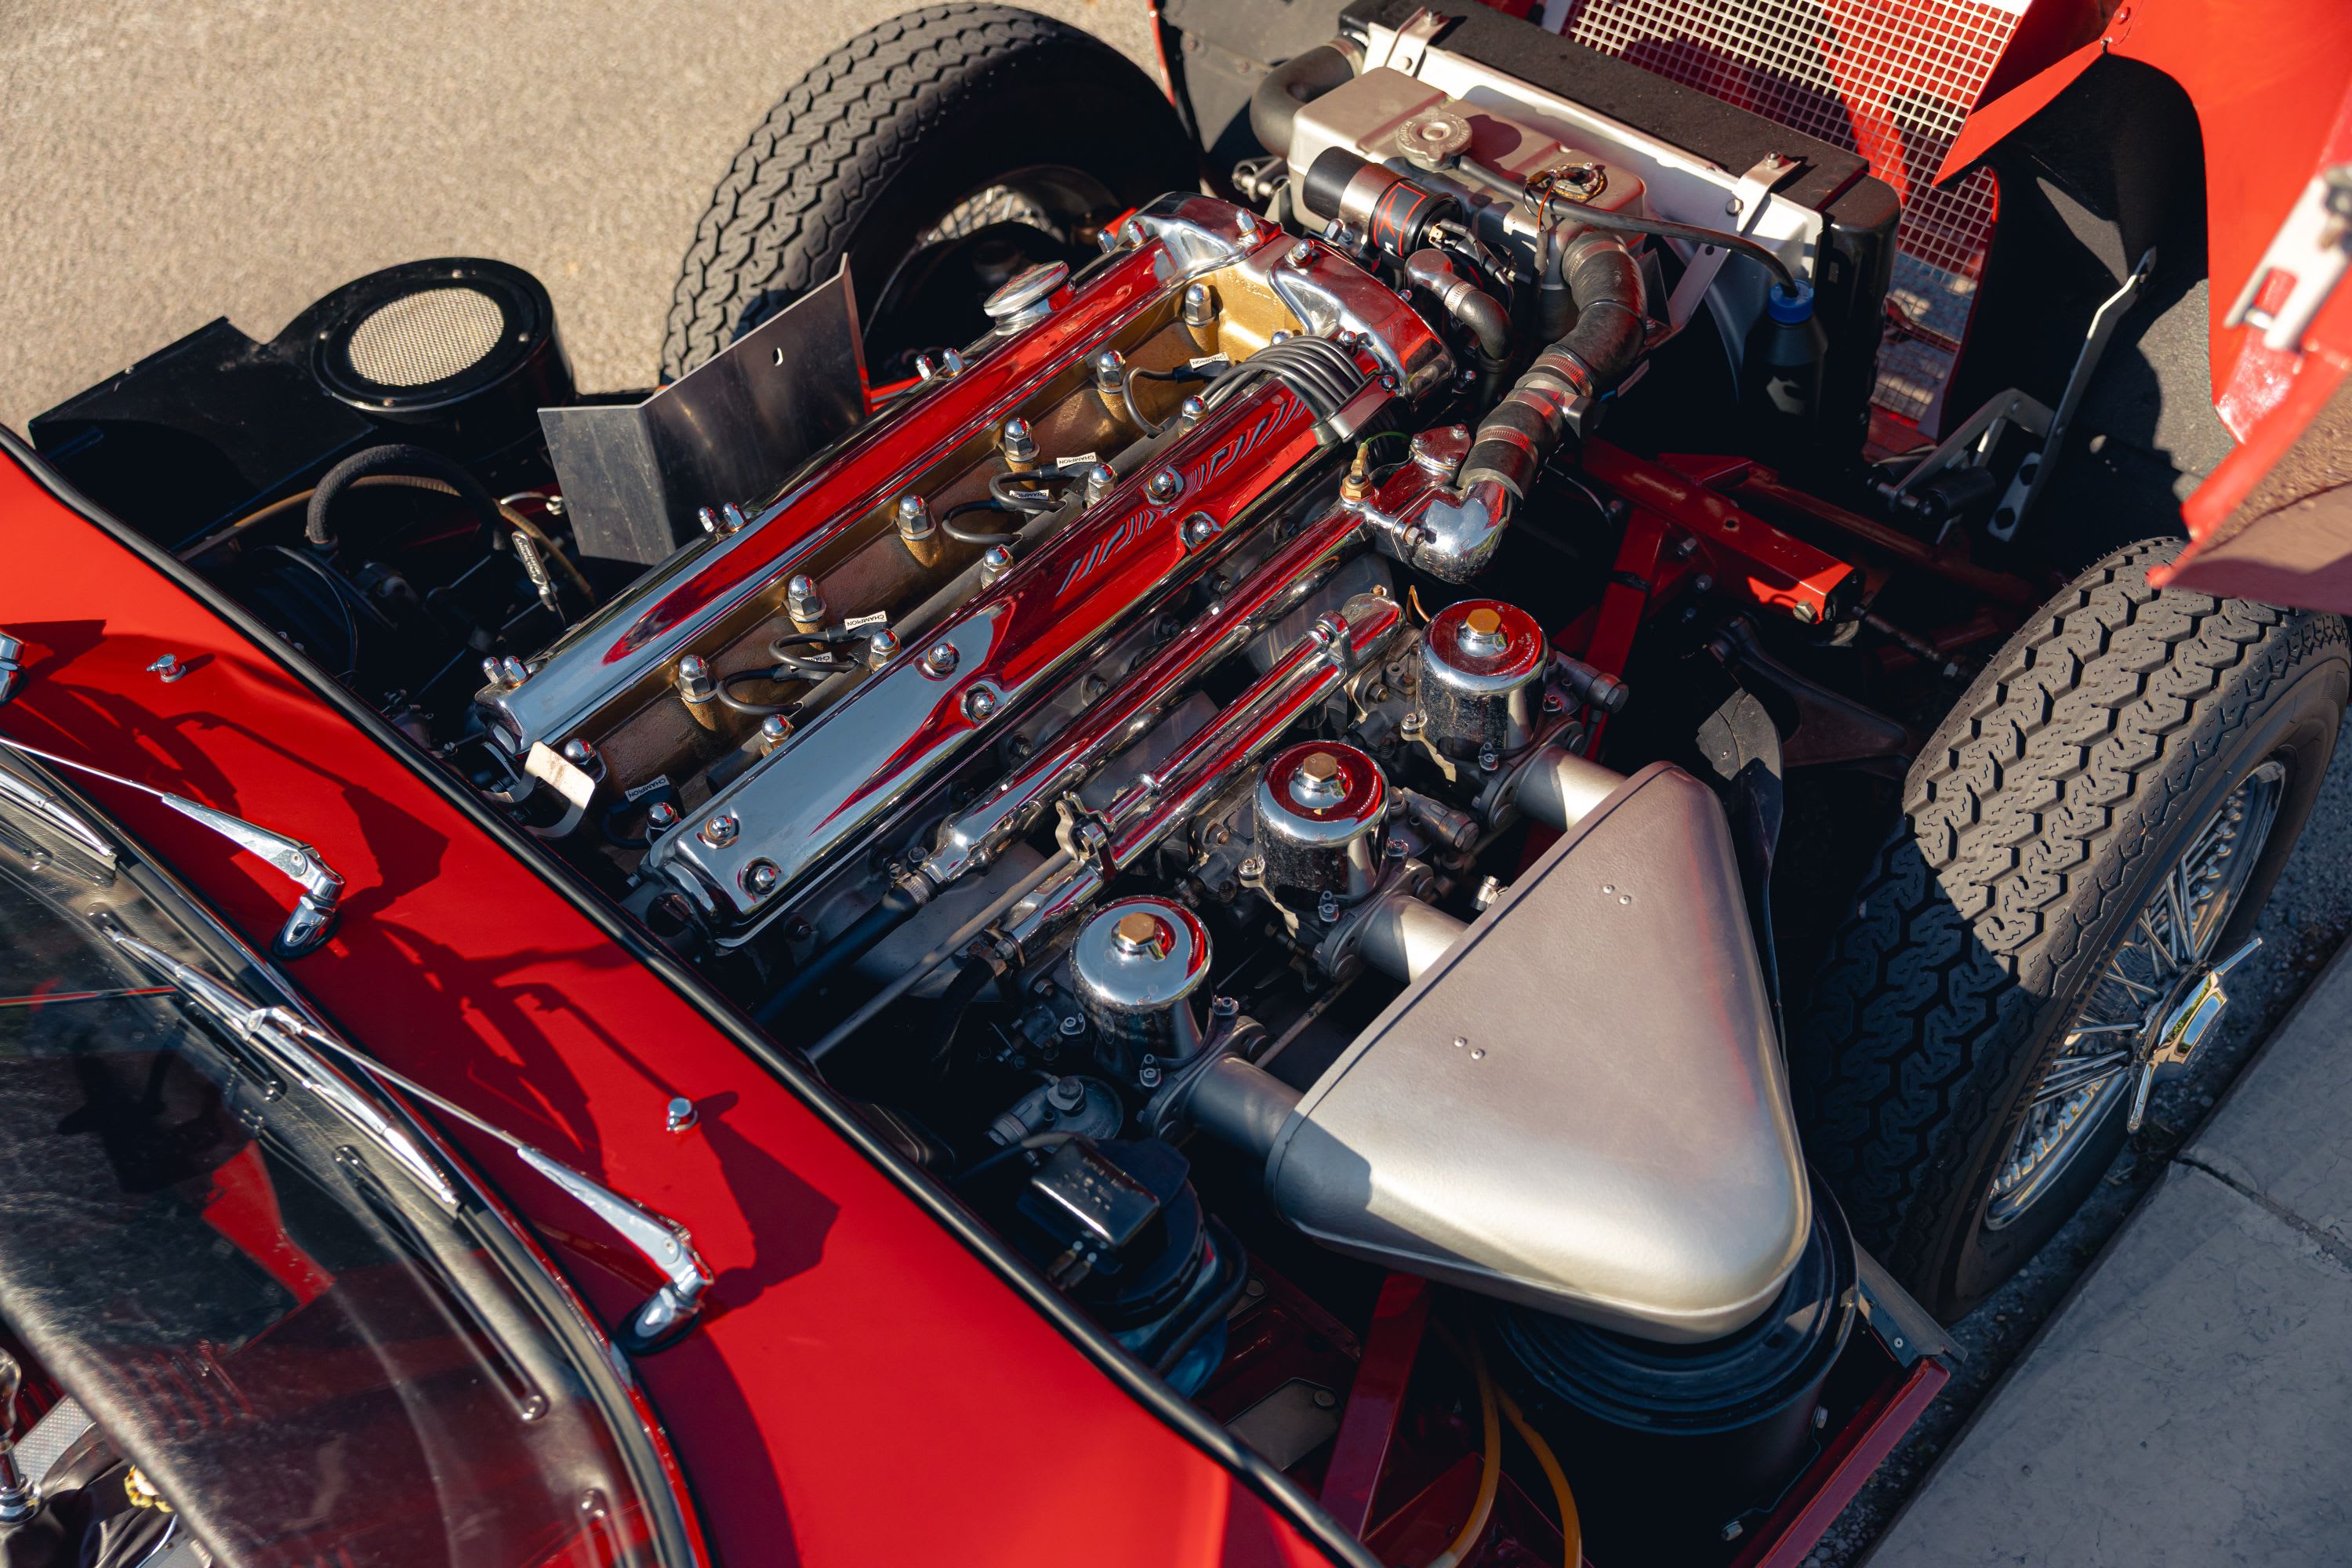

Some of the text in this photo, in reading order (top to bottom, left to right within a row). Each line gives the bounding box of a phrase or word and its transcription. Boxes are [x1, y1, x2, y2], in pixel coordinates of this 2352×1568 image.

[1059, 455, 1094, 464] CHAMPION
[847, 614, 884, 626] CHAMPION
[628, 778, 666, 798] CHAMPION
